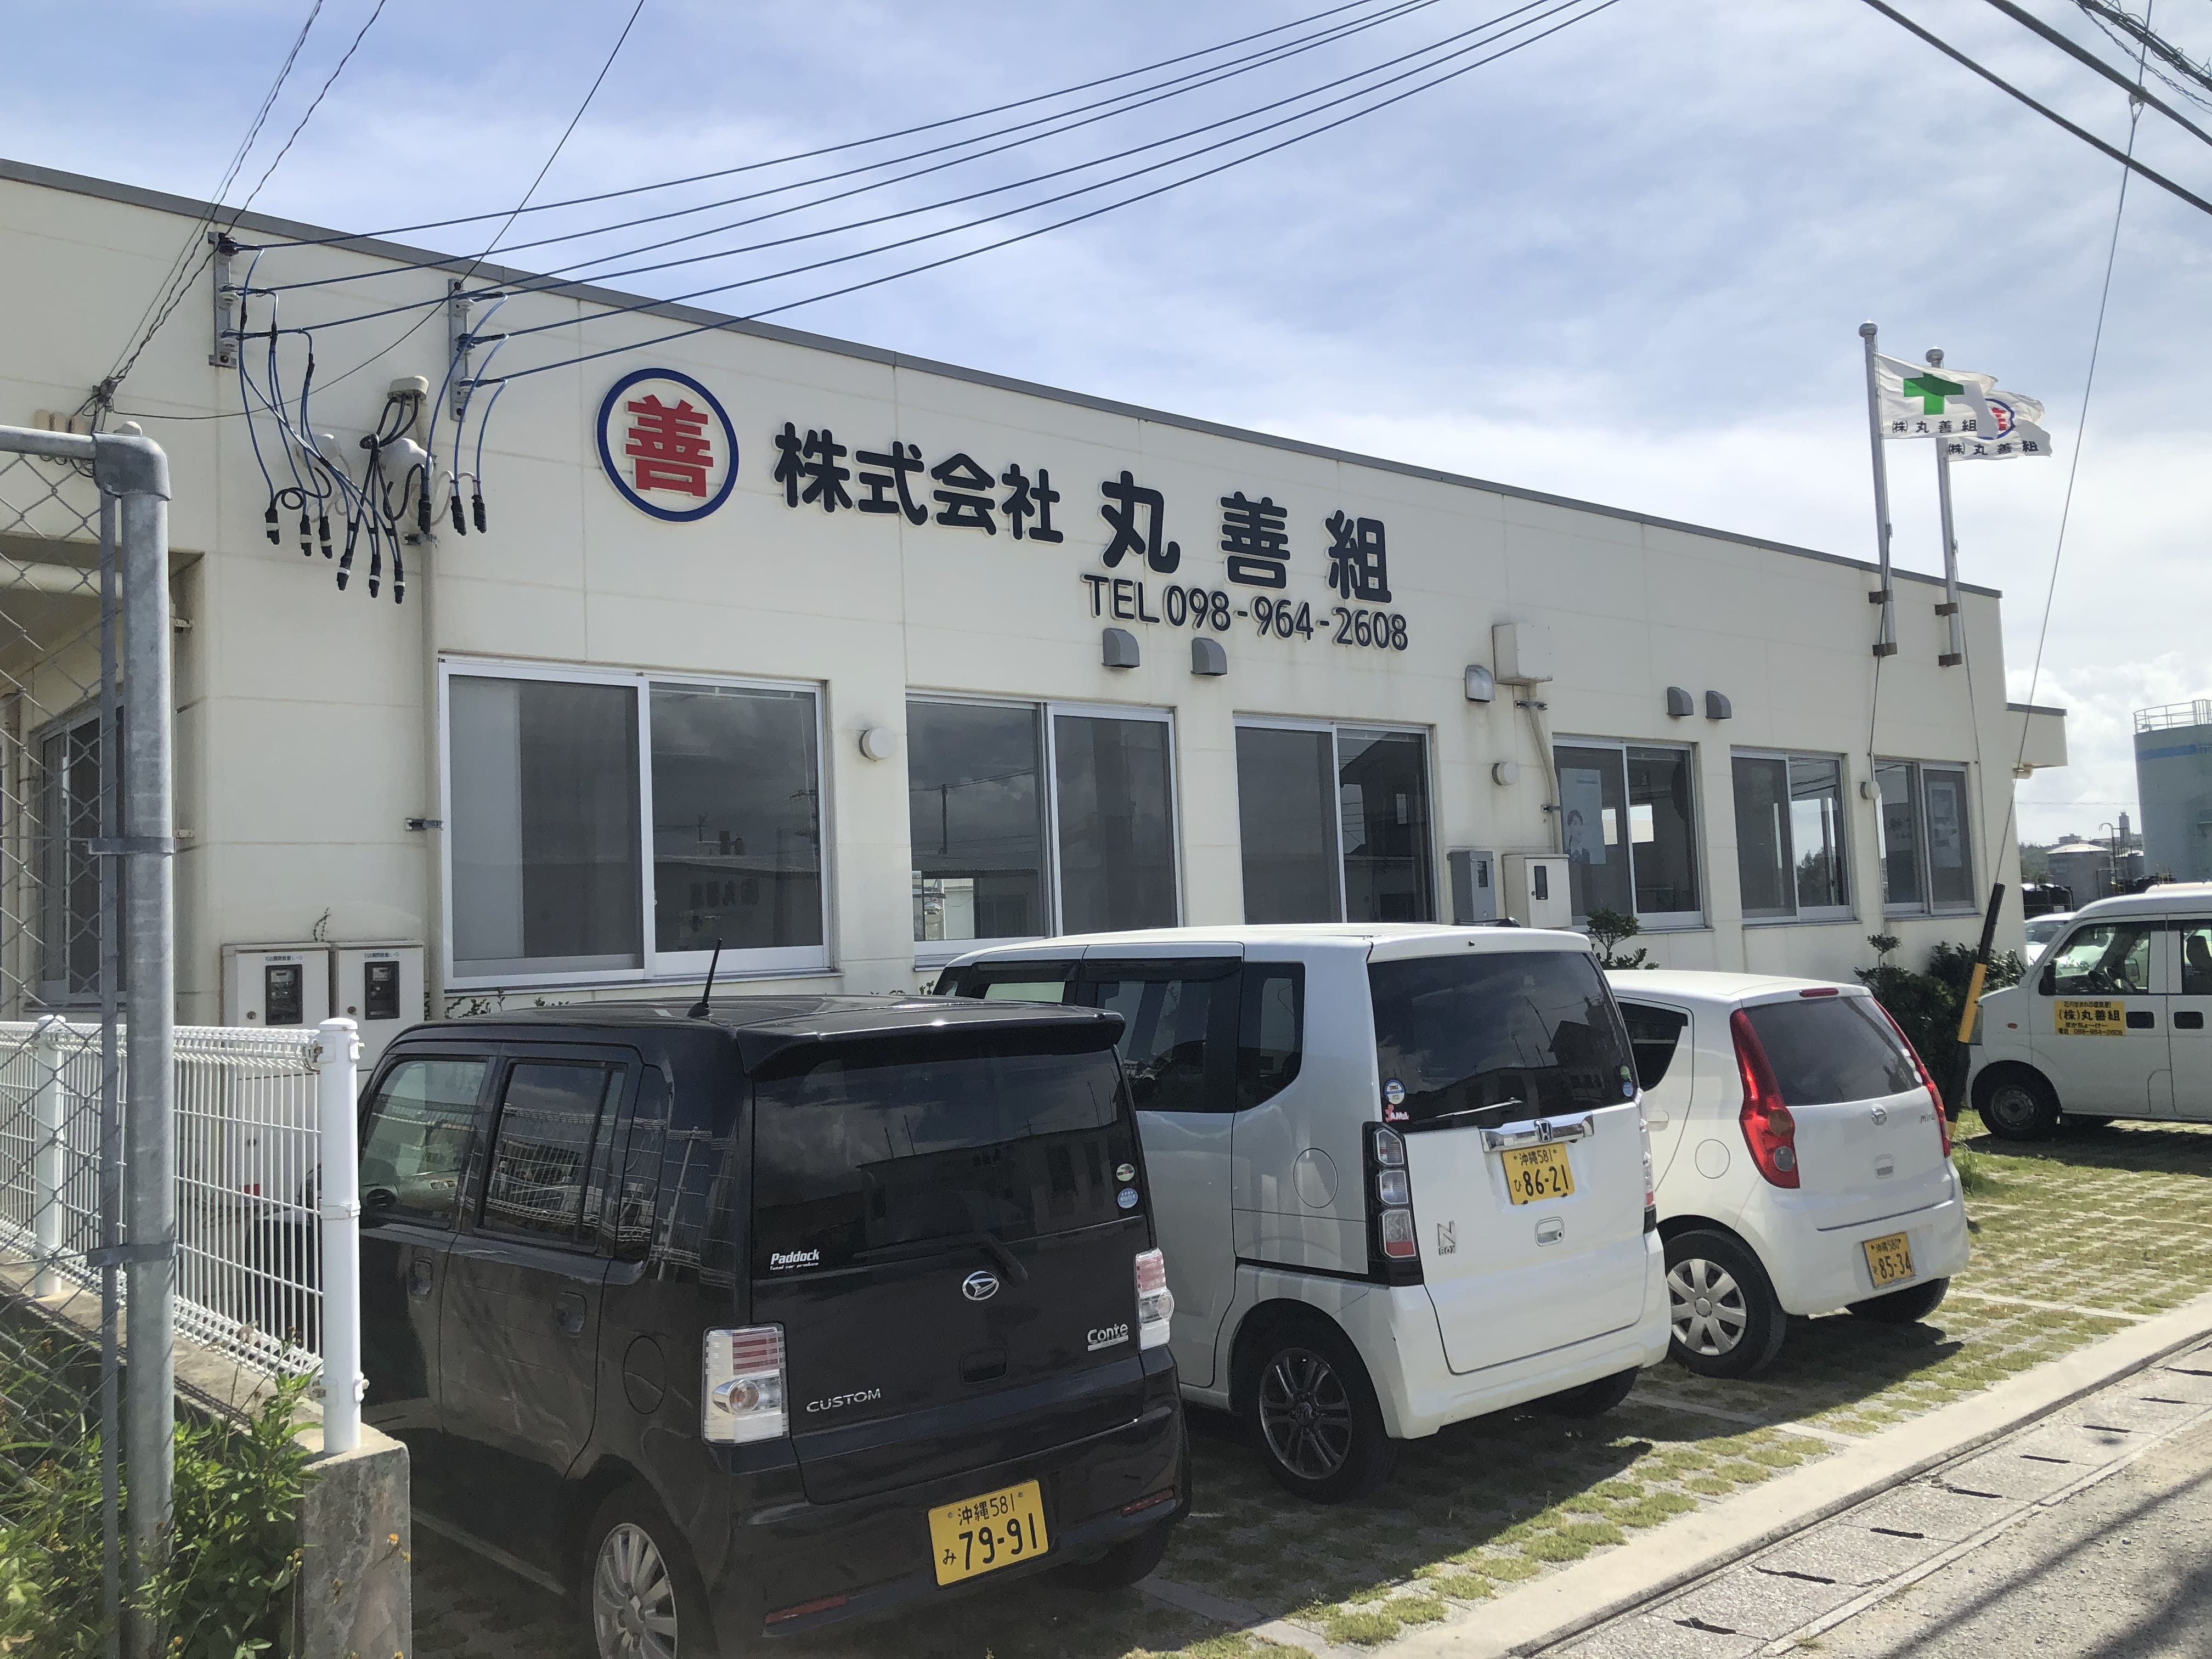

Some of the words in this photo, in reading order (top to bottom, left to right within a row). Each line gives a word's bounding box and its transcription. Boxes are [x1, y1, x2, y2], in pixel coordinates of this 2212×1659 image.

[625, 394, 714, 498] 善
[774, 421, 1064, 544] 株式会社
[1099, 470, 1392, 603] 丸善組
[1519, 1148, 1553, 1166] 沖縄581
[1514, 1179, 1521, 1192] ひ
[1437, 1220, 1457, 1247] N
[770, 1249, 820, 1265] Paddock
[1087, 1323, 1128, 1345] Conte
[806, 1389, 881, 1413] CUSTOM
[958, 1492, 1015, 1526] 沖縄581
[943, 1548, 957, 1565] み
